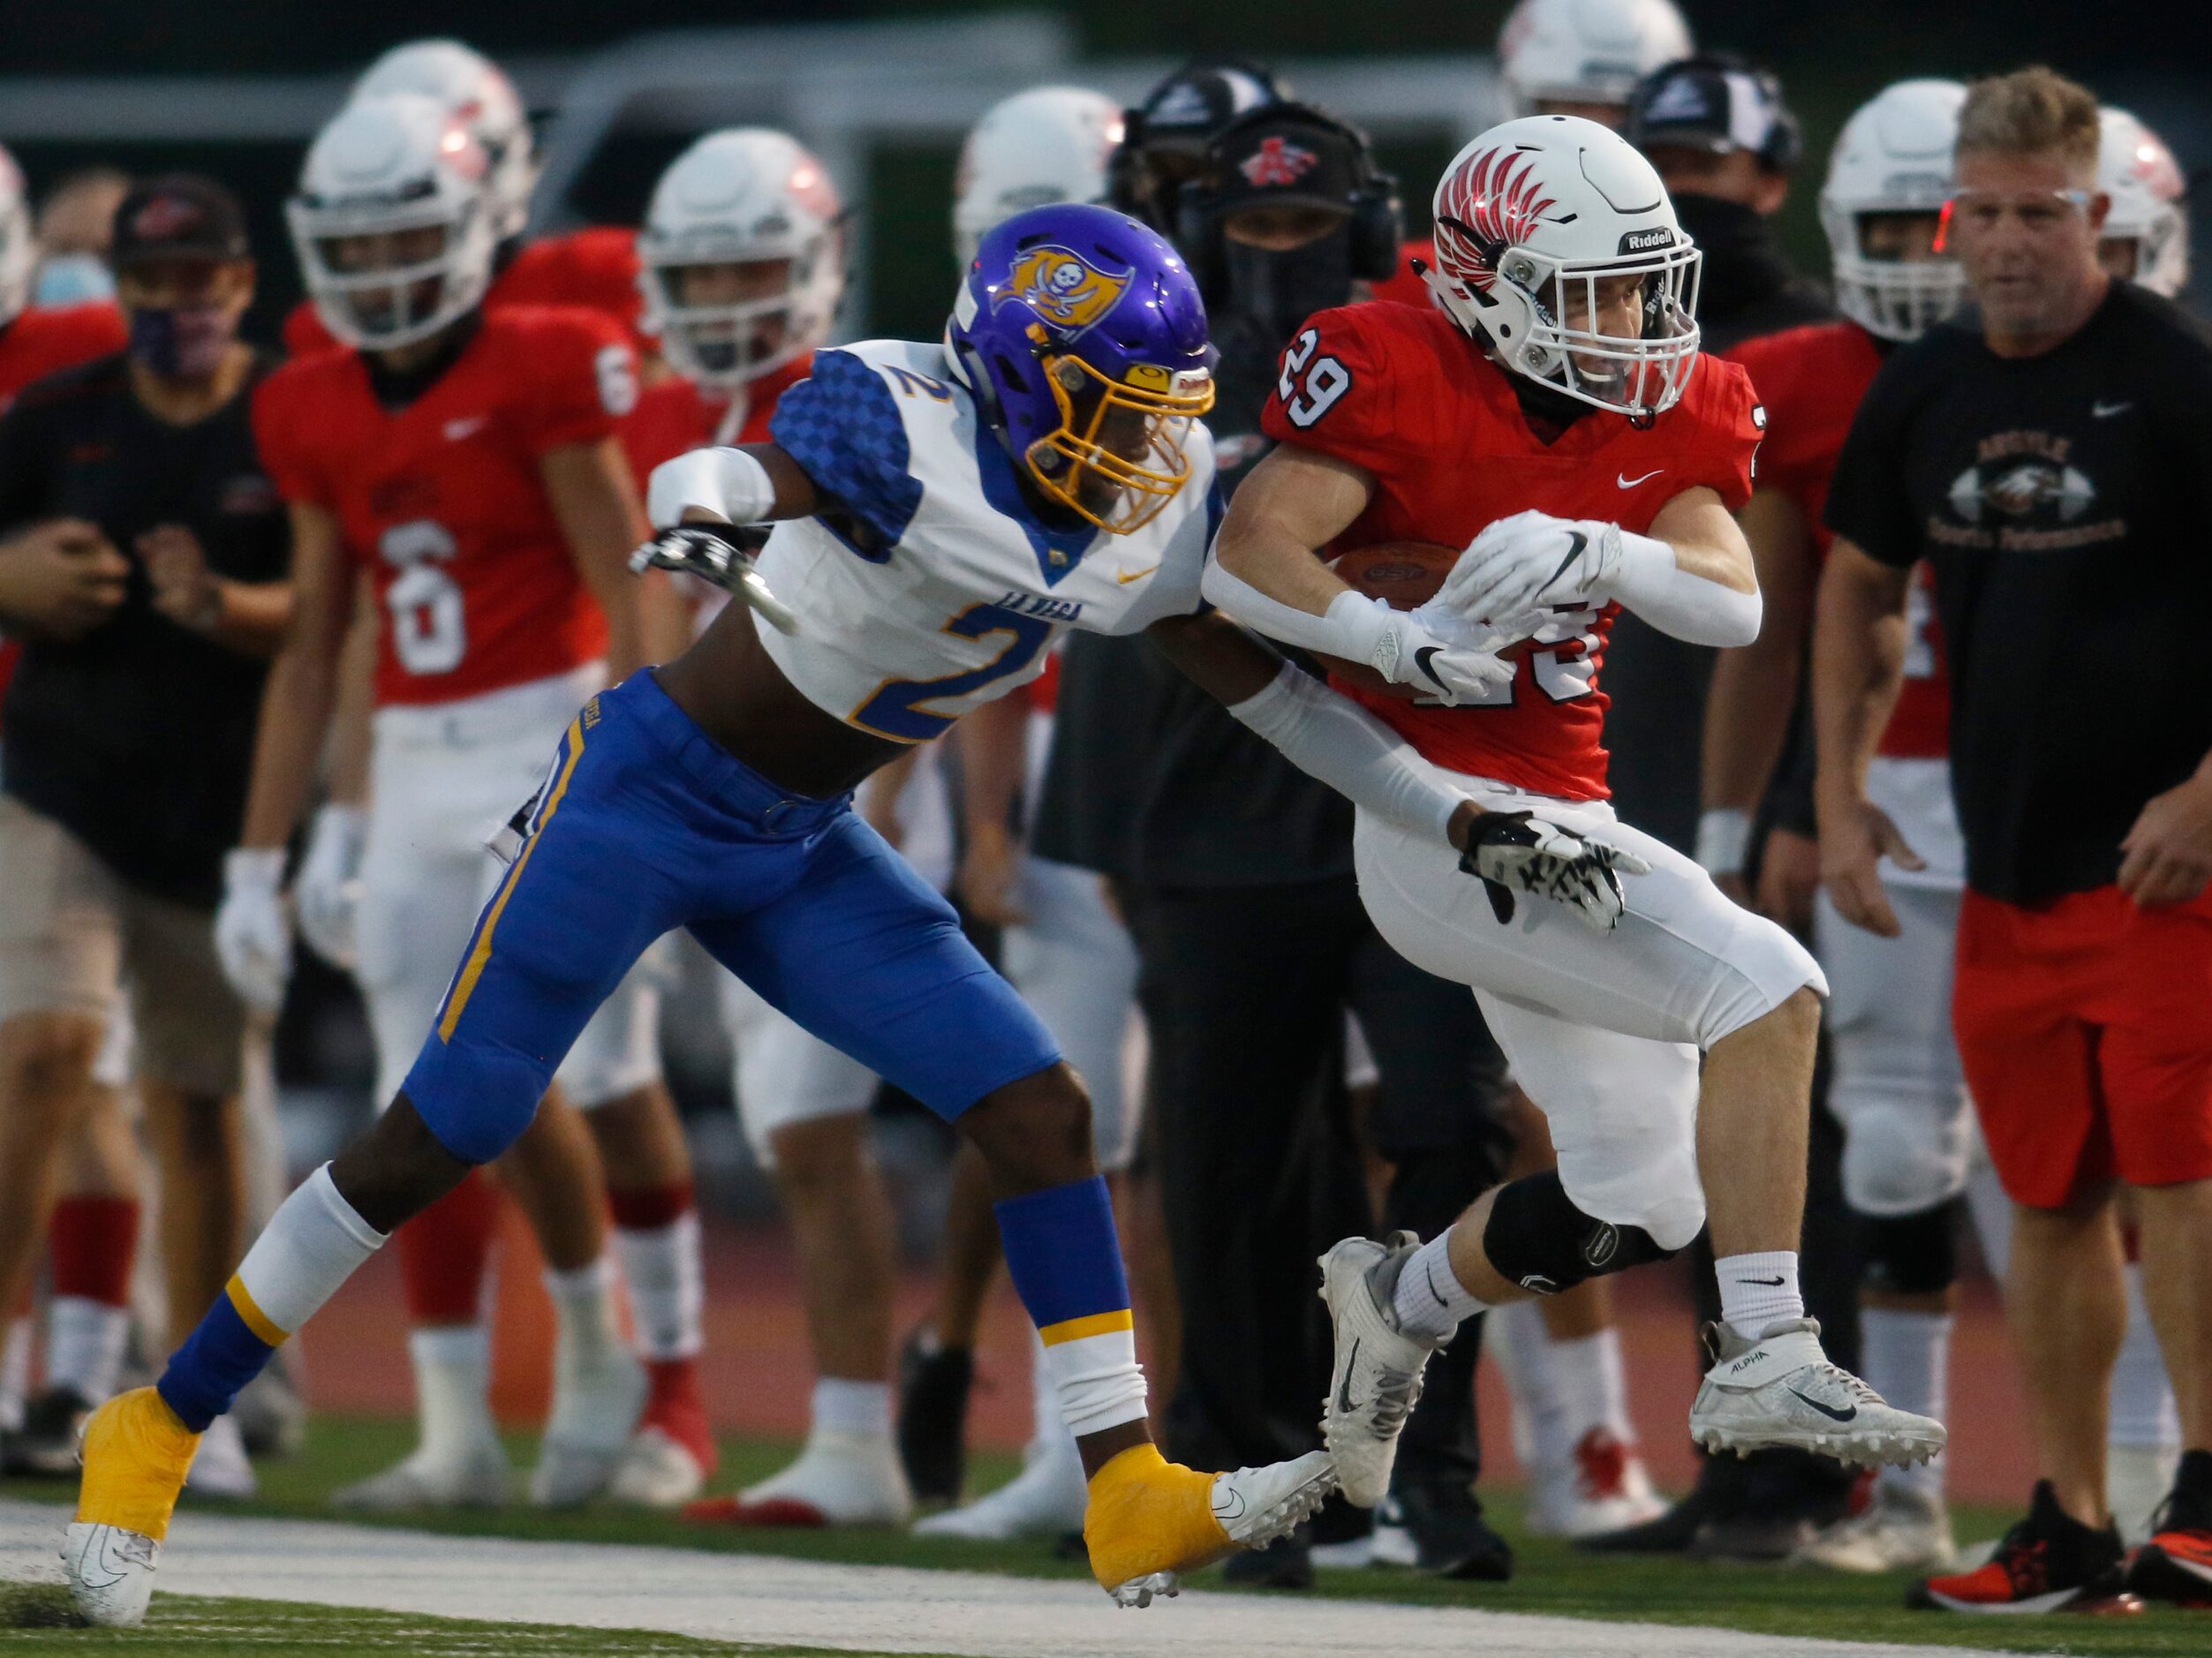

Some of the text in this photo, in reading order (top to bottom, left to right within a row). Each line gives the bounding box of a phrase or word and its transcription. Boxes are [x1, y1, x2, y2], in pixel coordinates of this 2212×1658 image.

[1628, 230, 1672, 249] Riddell
[594, 343, 639, 416] 6
[882, 363, 952, 404] 2
[1278, 327, 1350, 428] 29
[378, 518, 468, 675] 6
[1025, 597, 1083, 622] VEGA
[846, 602, 1055, 744] 2
[1730, 1351, 1770, 1375] ALPHA
